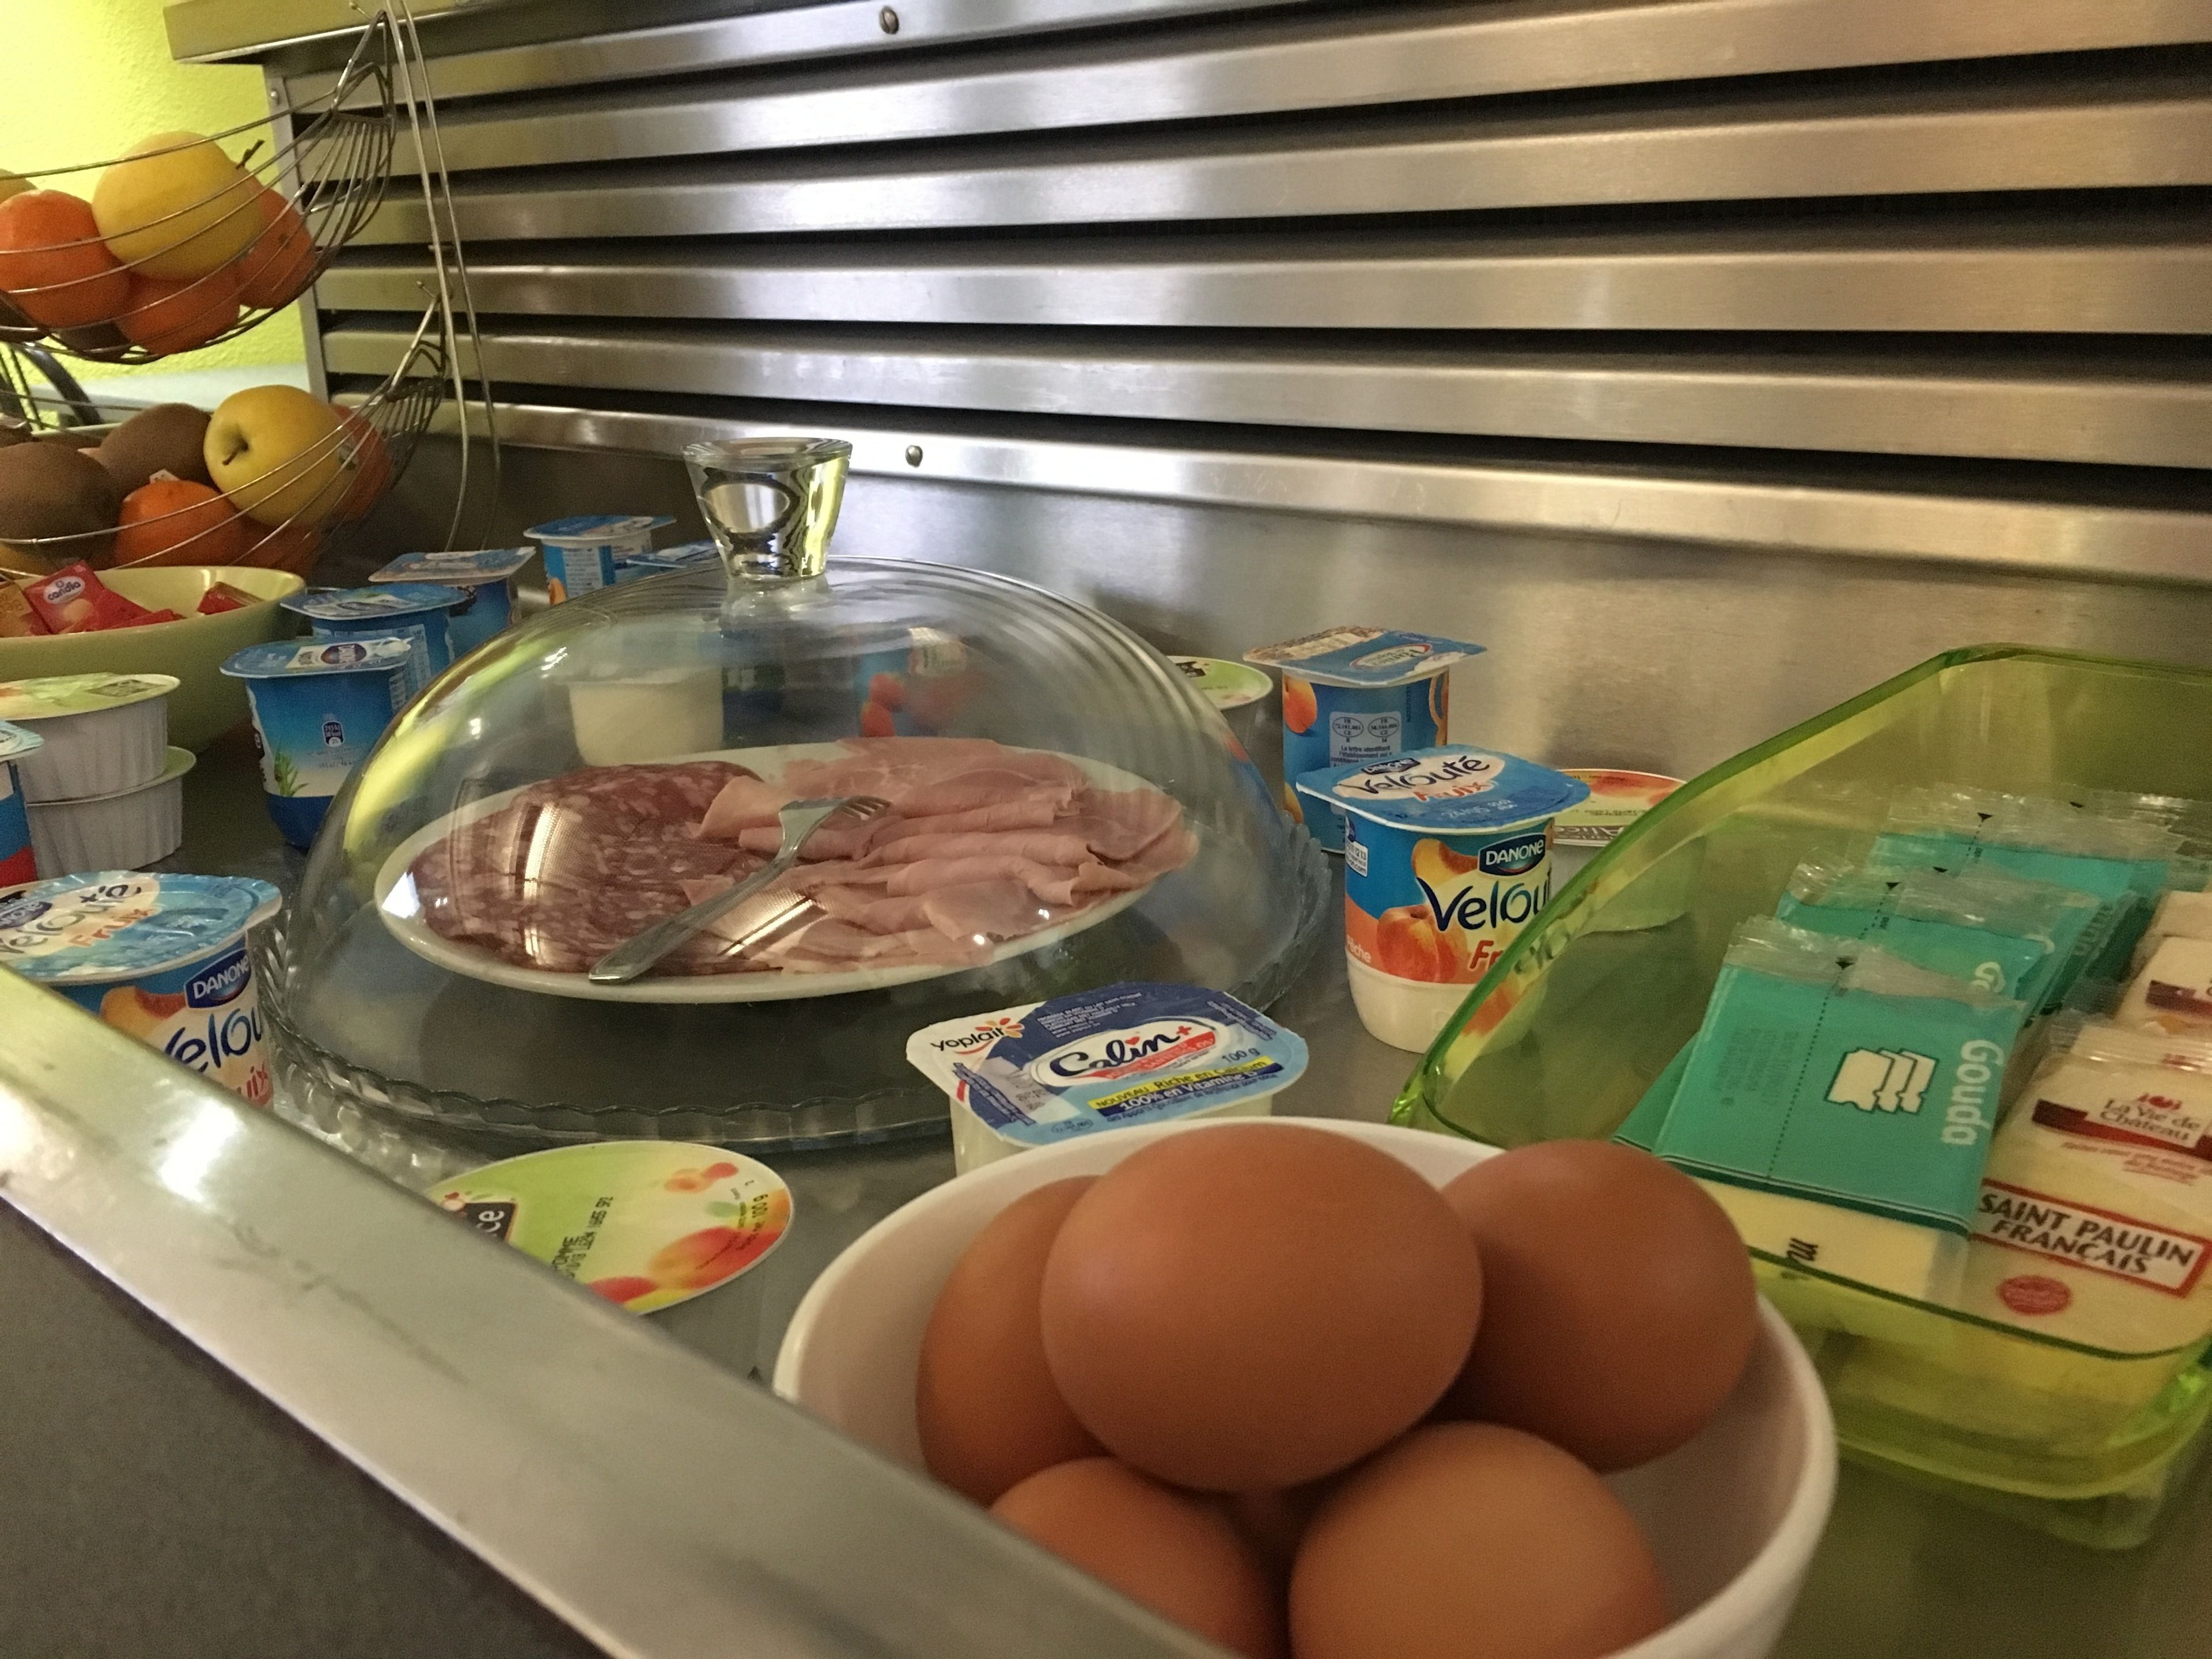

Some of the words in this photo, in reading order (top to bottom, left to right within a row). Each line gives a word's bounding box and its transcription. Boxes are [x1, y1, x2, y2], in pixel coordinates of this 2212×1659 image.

[48, 581, 81, 600] candia
[1332, 755, 1491, 794] Velouté
[1365, 757, 1412, 773] DANONE
[1486, 838, 1544, 866] DANONE
[1416, 874, 1550, 931] Velou
[193, 955, 250, 999] DANONE
[1222, 1050, 1247, 1063] 100
[1248, 1048, 1260, 1056] g
[1096, 1087, 1149, 1108] NOUVEAU
[1154, 1074, 1192, 1089] Riche
[1195, 1071, 1211, 1080] en
[1214, 1060, 1267, 1075] Calcium
[1120, 1092, 1162, 1111] 100%
[1164, 1086, 1181, 1097] en
[1181, 1073, 1244, 1092] Vitamine
[1940, 1040, 2006, 1145] Gouda
[475, 1209, 506, 1238] ce
[1979, 1194, 2071, 1230] SAINT
[2076, 1219, 2194, 1267] PAULIN
